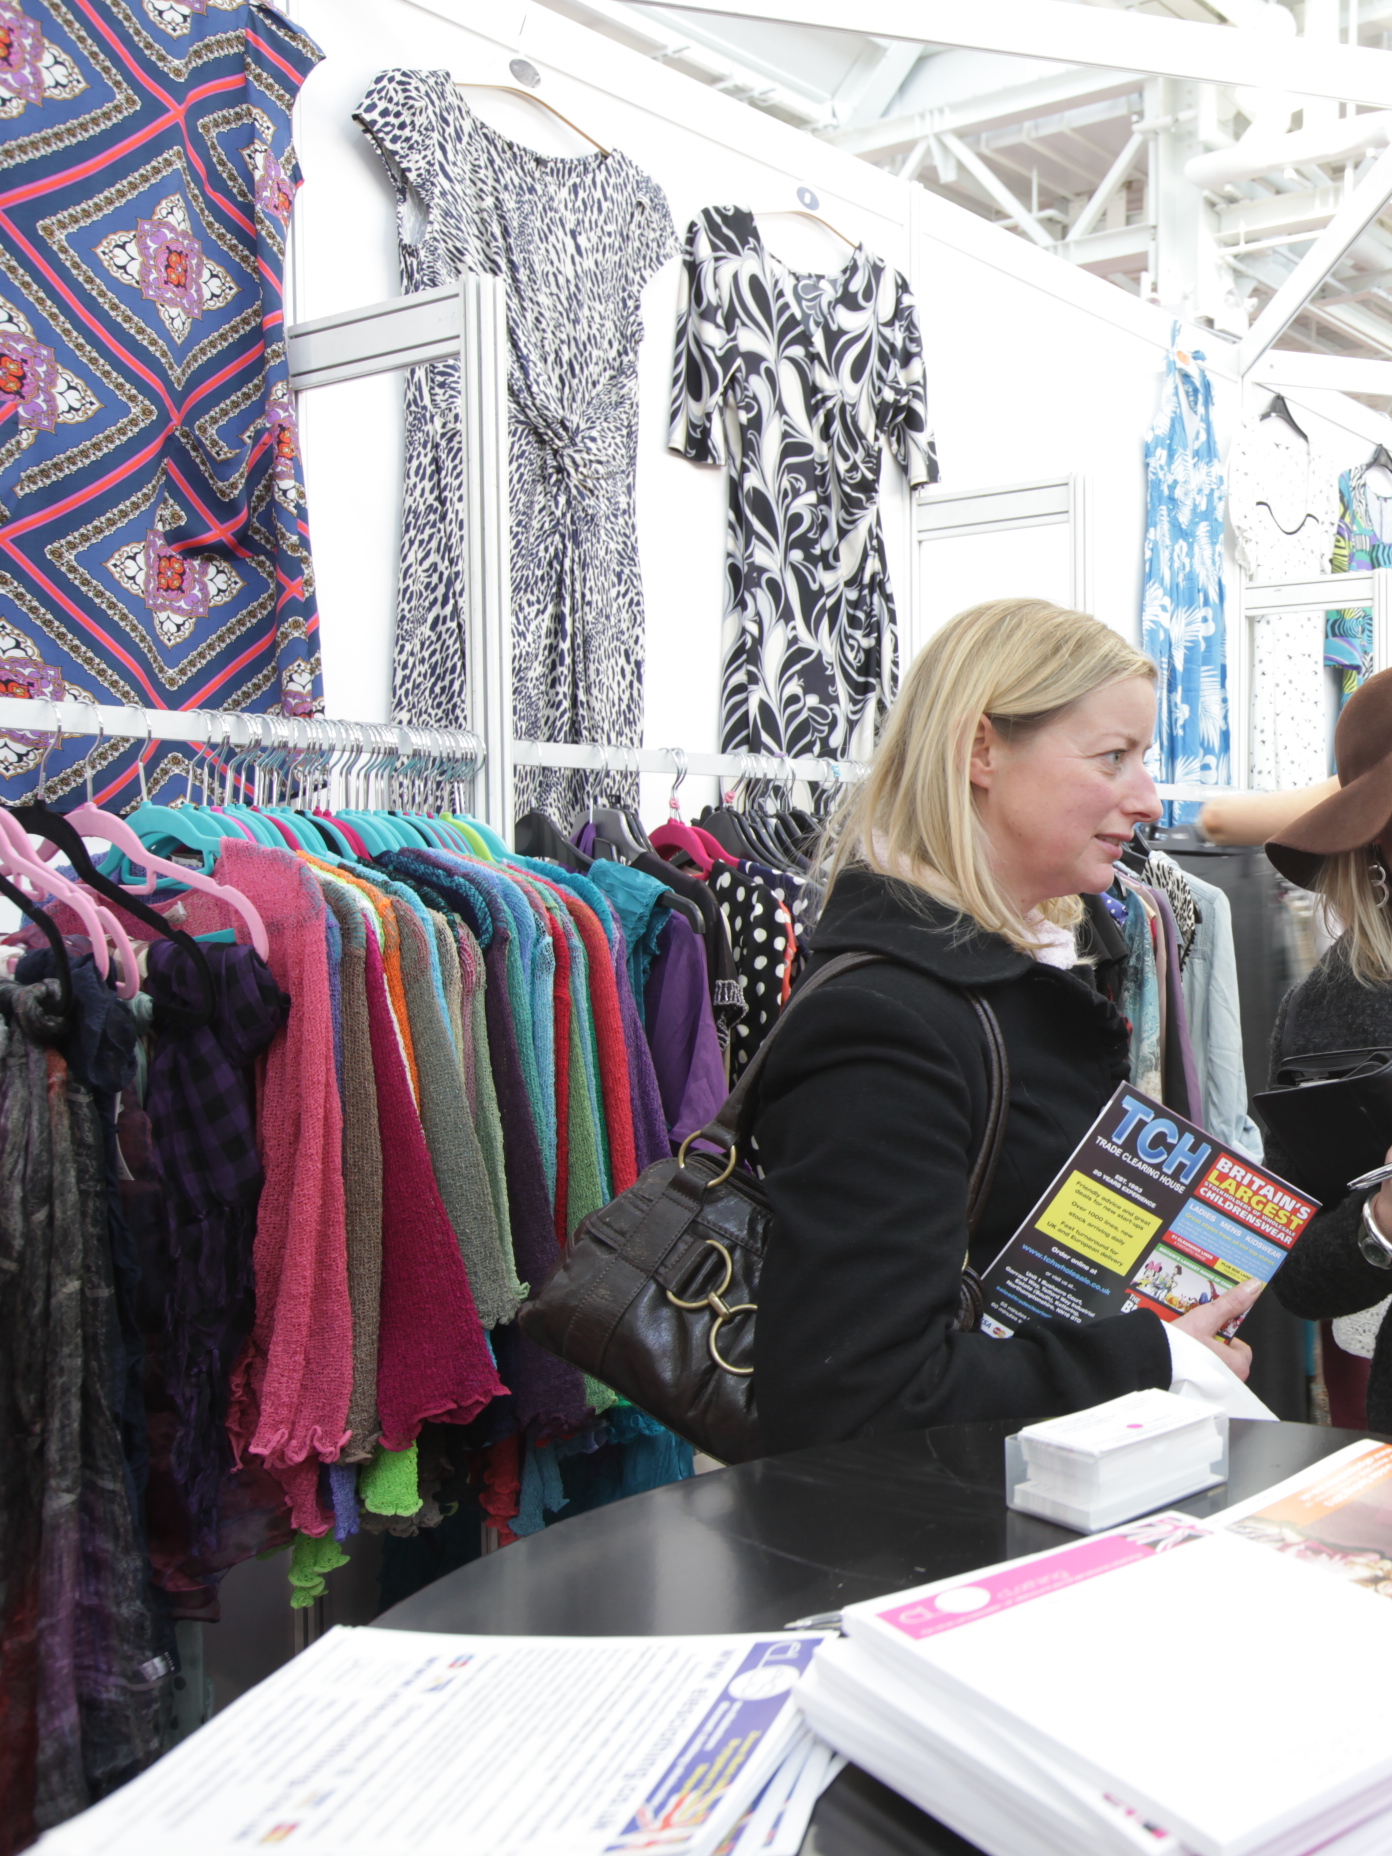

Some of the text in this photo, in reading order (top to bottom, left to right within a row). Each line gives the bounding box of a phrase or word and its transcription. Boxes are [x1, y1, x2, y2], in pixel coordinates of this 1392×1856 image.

[1111, 1094, 1212, 1185] TCH
[1093, 1135, 1186, 1194] TRADE CLEARING HOUSE
[1113, 1173, 1143, 1194] EST. 1993
[1074, 1180, 1151, 1227] Friendly advice and great
[1092, 1168, 1157, 1208] 20 YEARS EXPERIENCE
[1205, 1167, 1305, 1233] LARGEST
[1213, 1156, 1313, 1221] BRITAIN'S
[1067, 1210, 1126, 1246] stock arriving daily
[1070, 1200, 1134, 1239] Over 1000 lines, new
[1073, 1187, 1144, 1231] deals for new start-ups
[1184, 1211, 1202, 1225] Great
[1217, 1230, 1232, 1242] from
[1197, 1185, 1294, 1245] CHILDRENSWEAR
[1202, 1180, 1296, 1237] STOCKHOLDERS OF WHOLESALE
[1045, 1220, 1124, 1267] UK and European delivery
[1059, 1219, 1119, 1256] Fast turnaround for
[1176, 1236, 1202, 1253] CLEARANCE
[1188, 1202, 1282, 1259] LADIES MENS KIDSWEAR
[1020, 1241, 1111, 1297] www.tchwholesale.co.uk
[1050, 1245, 1098, 1275] Order online at
[1050, 1273, 1062, 1283] visit
[1239, 1271, 1251, 1280] LADI
[1004, 1265, 1029, 1282] Garrard
[1058, 1295, 1071, 1306] Way
[1070, 1301, 1096, 1318] Industrial
[1013, 1277, 1034, 1292] Estate
[1024, 1270, 1038, 1280] Unit
[1040, 1278, 1067, 1297] Bushacre
[1219, 1279, 1233, 1289] CHAR
[996, 1305, 1019, 1322] minutes
[1005, 1304, 1028, 1320] minutes
